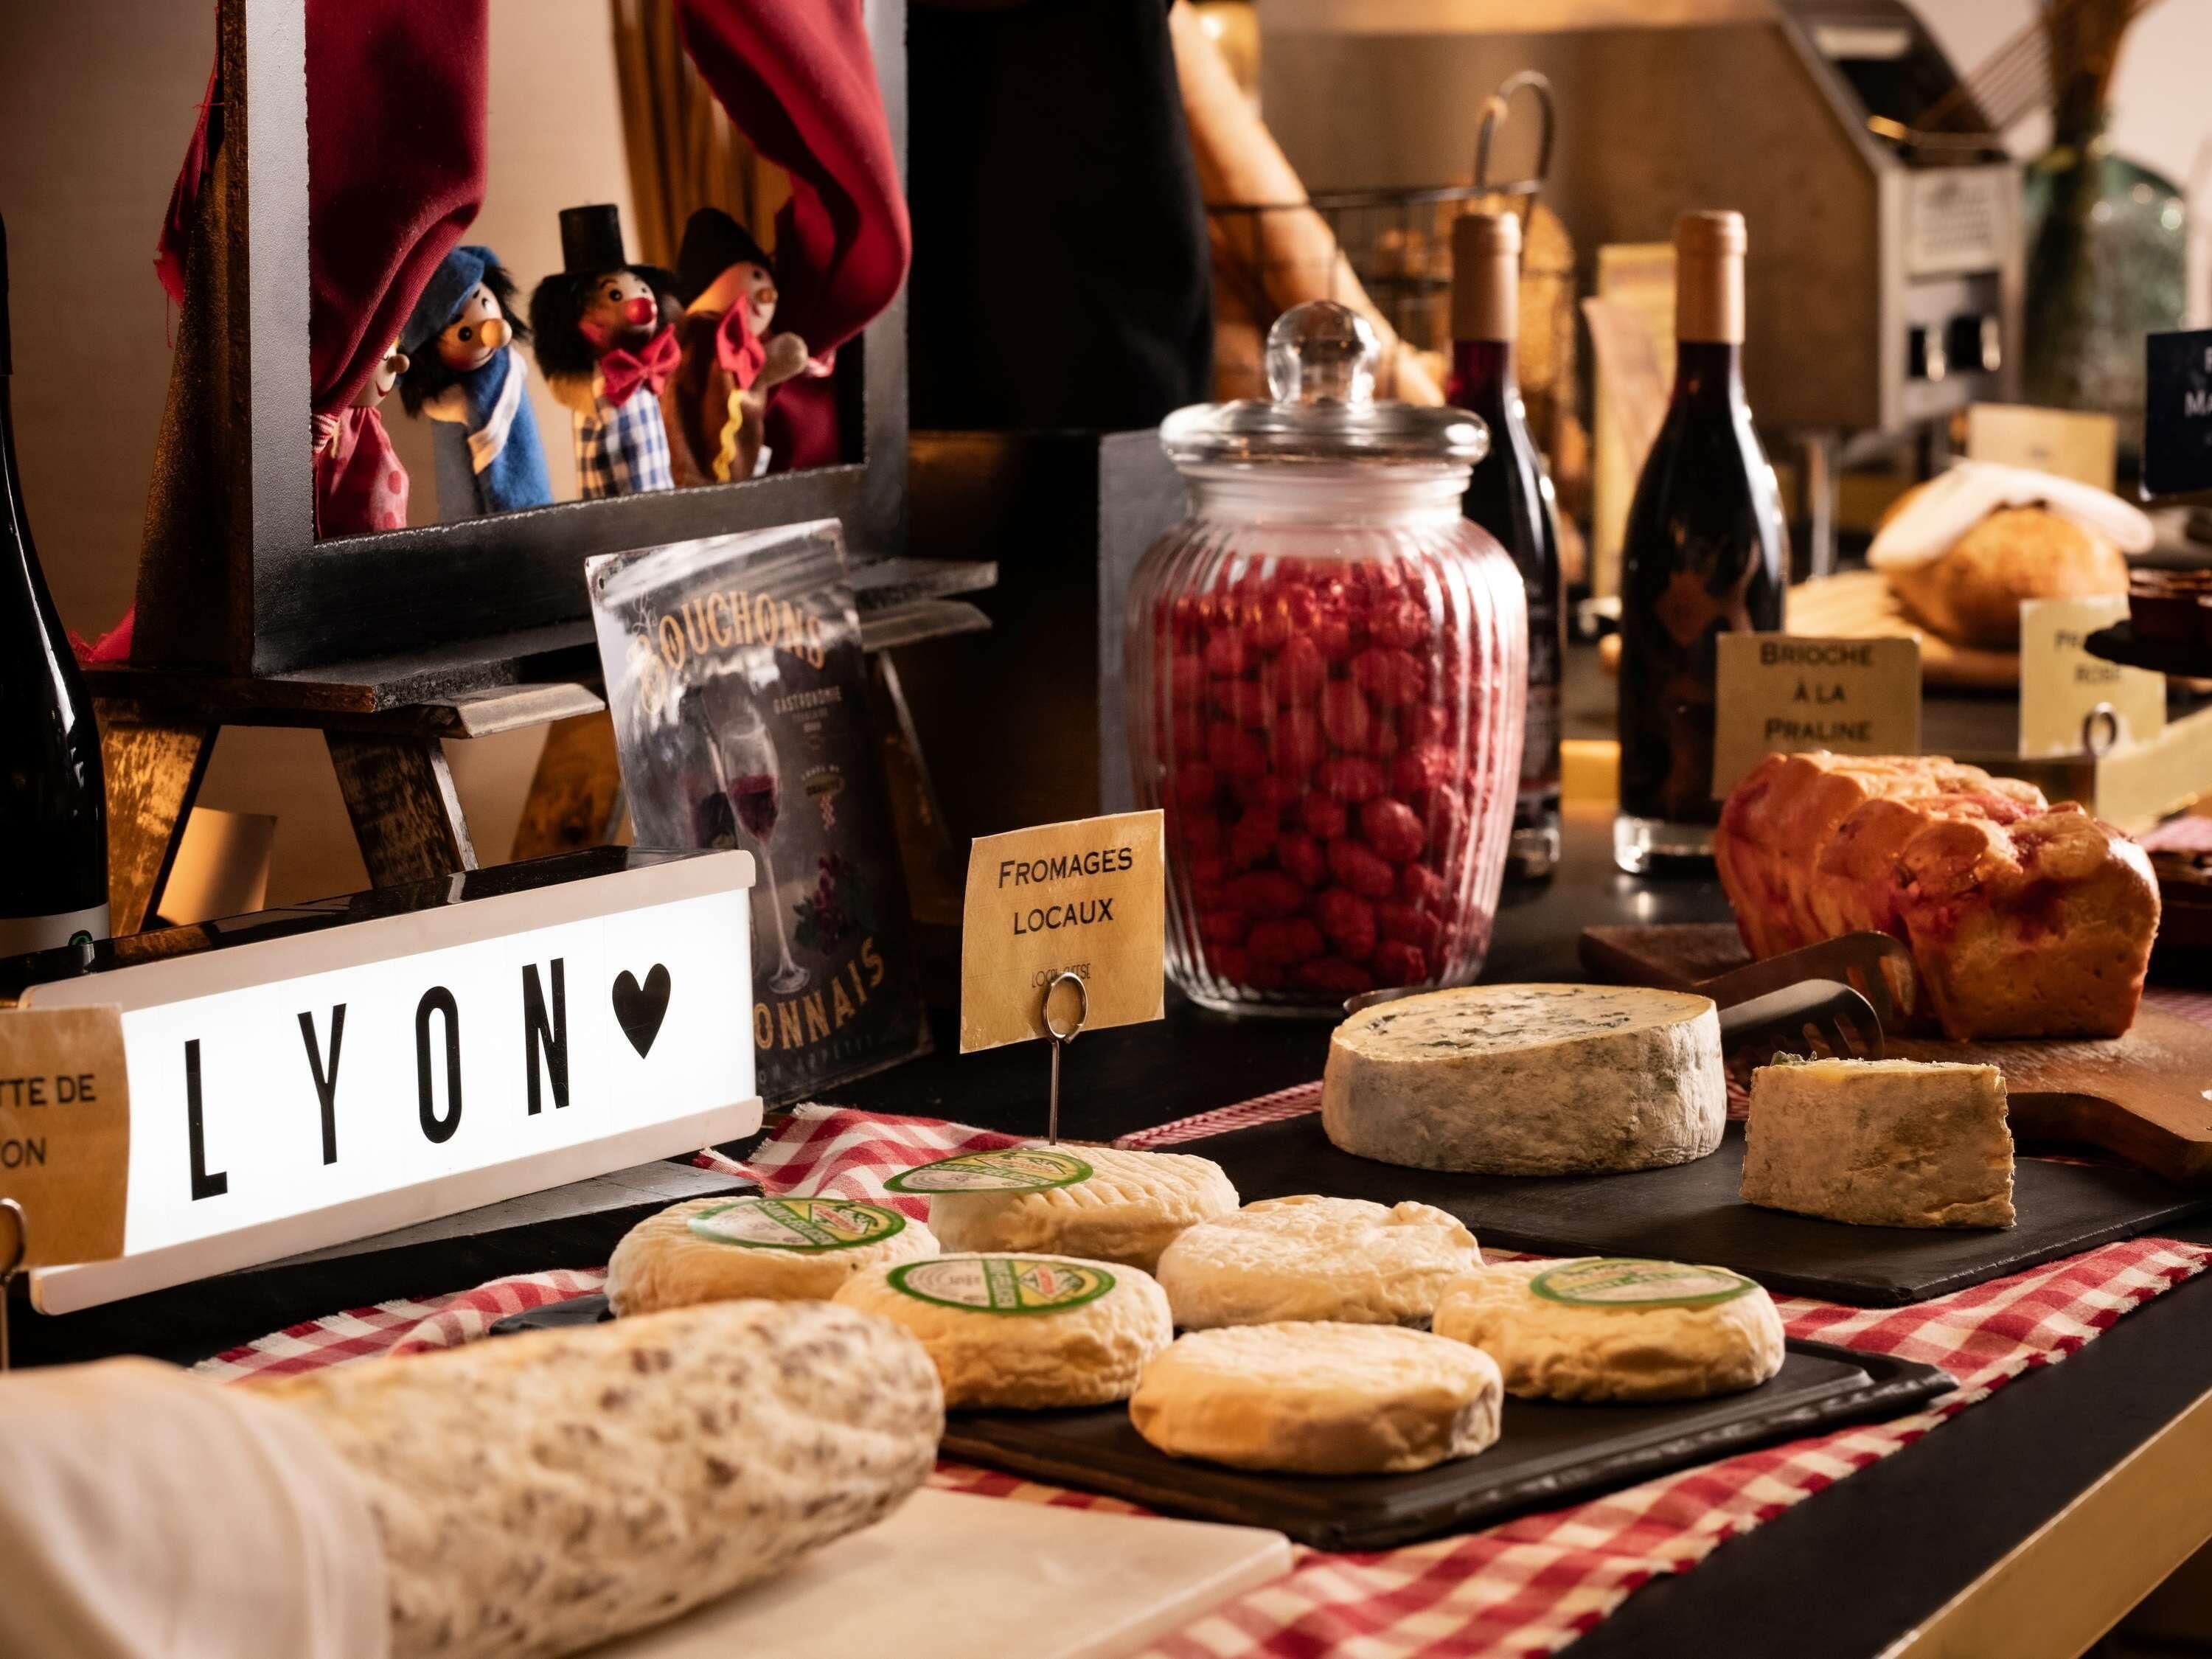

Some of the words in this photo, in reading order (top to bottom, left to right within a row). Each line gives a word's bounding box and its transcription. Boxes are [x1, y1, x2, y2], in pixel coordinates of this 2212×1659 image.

[1760, 641, 1874, 667] BRIOCHE
[1815, 682, 1846, 704] LA
[1764, 717, 1873, 743] PRALINE
[998, 847, 1133, 889] FROMAGES
[1013, 897, 1114, 936] LOCAUX
[754, 936, 886, 1050] ONNAIS
[57, 1073, 97, 1104] DE
[184, 957, 570, 1201] LYON
